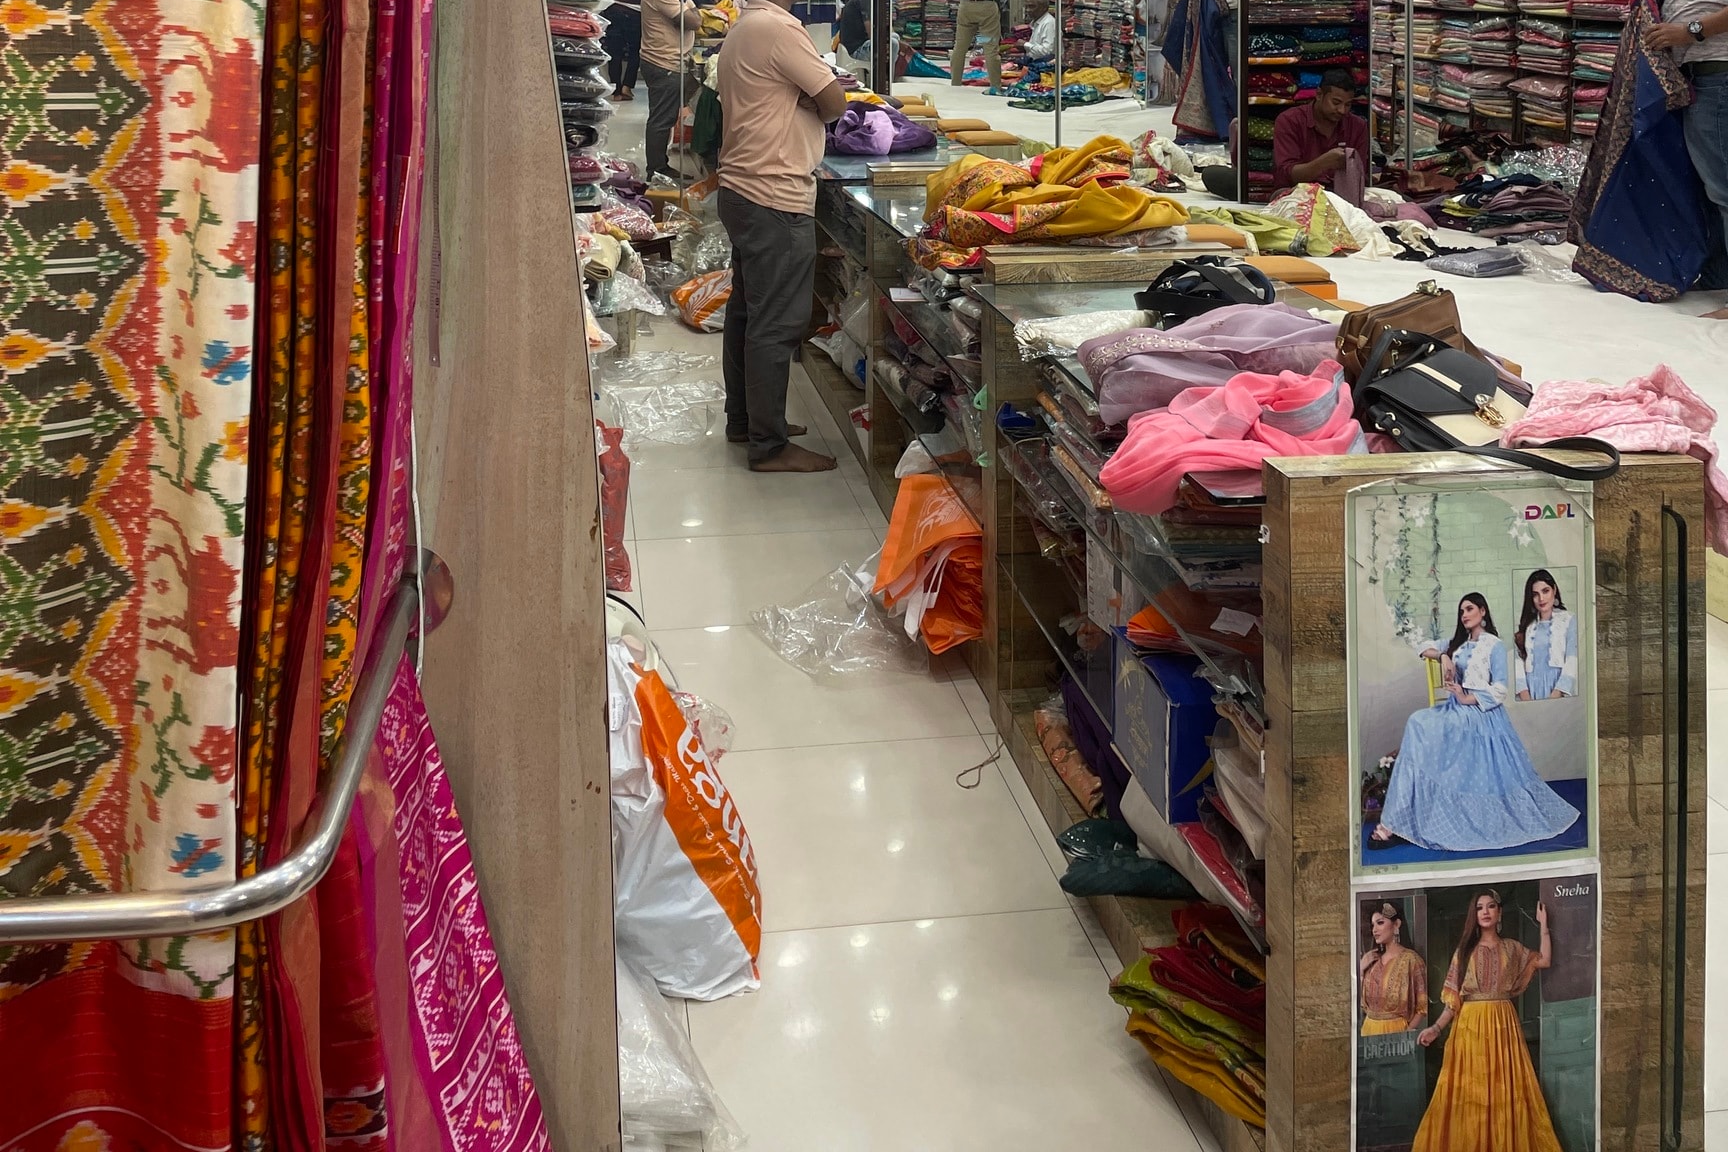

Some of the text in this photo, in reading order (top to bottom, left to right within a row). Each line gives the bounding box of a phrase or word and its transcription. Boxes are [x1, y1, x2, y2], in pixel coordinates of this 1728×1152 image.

[1524, 503, 1575, 520] DAPL
[680, 782, 695, 805] Dress
[1553, 883, 1590, 898] Sneha
